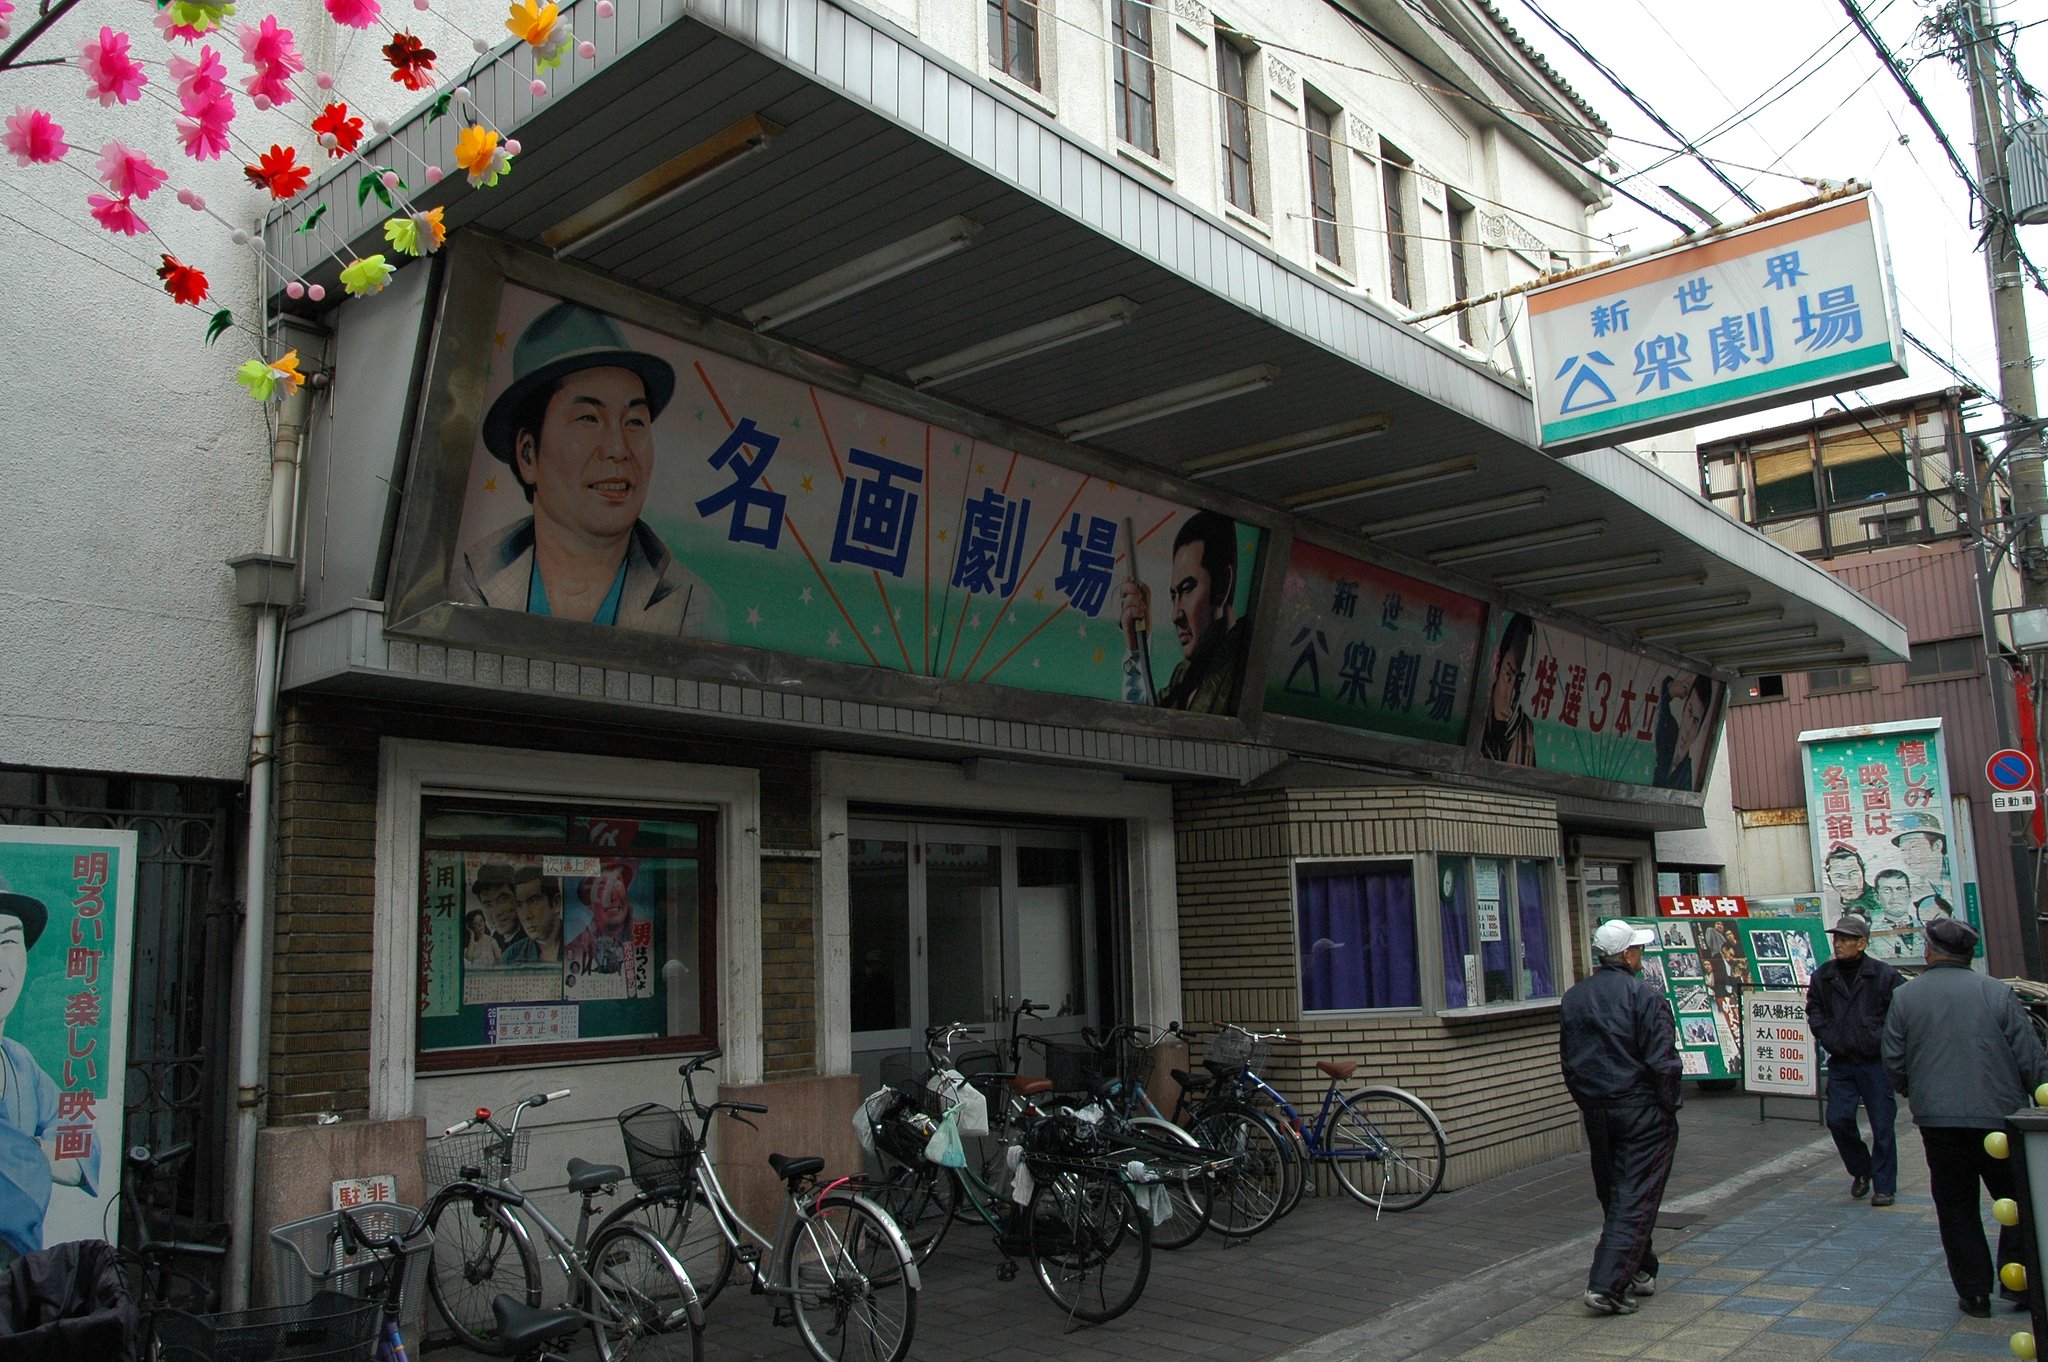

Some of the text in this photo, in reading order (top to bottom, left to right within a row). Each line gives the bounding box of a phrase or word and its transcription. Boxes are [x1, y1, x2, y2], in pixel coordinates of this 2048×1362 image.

[1590, 250, 1809, 338] 新世界
[1554, 284, 1864, 415] 公楽劇場
[694, 417, 1118, 618] 名画劇場
[1331, 577, 1450, 642] 新世界
[1283, 626, 1459, 724] 公楽劇場
[1531, 654, 1660, 742] 特選3本立
[1858, 762, 1892, 835] 映画は
[1896, 740, 1935, 807] 懐しの
[1995, 795, 2033, 807] 自動車
[1821, 765, 1858, 852] 名画館へ
[1670, 897, 1739, 915] 上映中
[633, 921, 652, 990] 男はつらいよ
[1752, 1004, 1804, 1020] 御入場料金
[1757, 1027, 1804, 1041] 大人 1000円
[1757, 1046, 1804, 1060] 学生 800円
[1779, 1067, 1803, 1081] 600円
